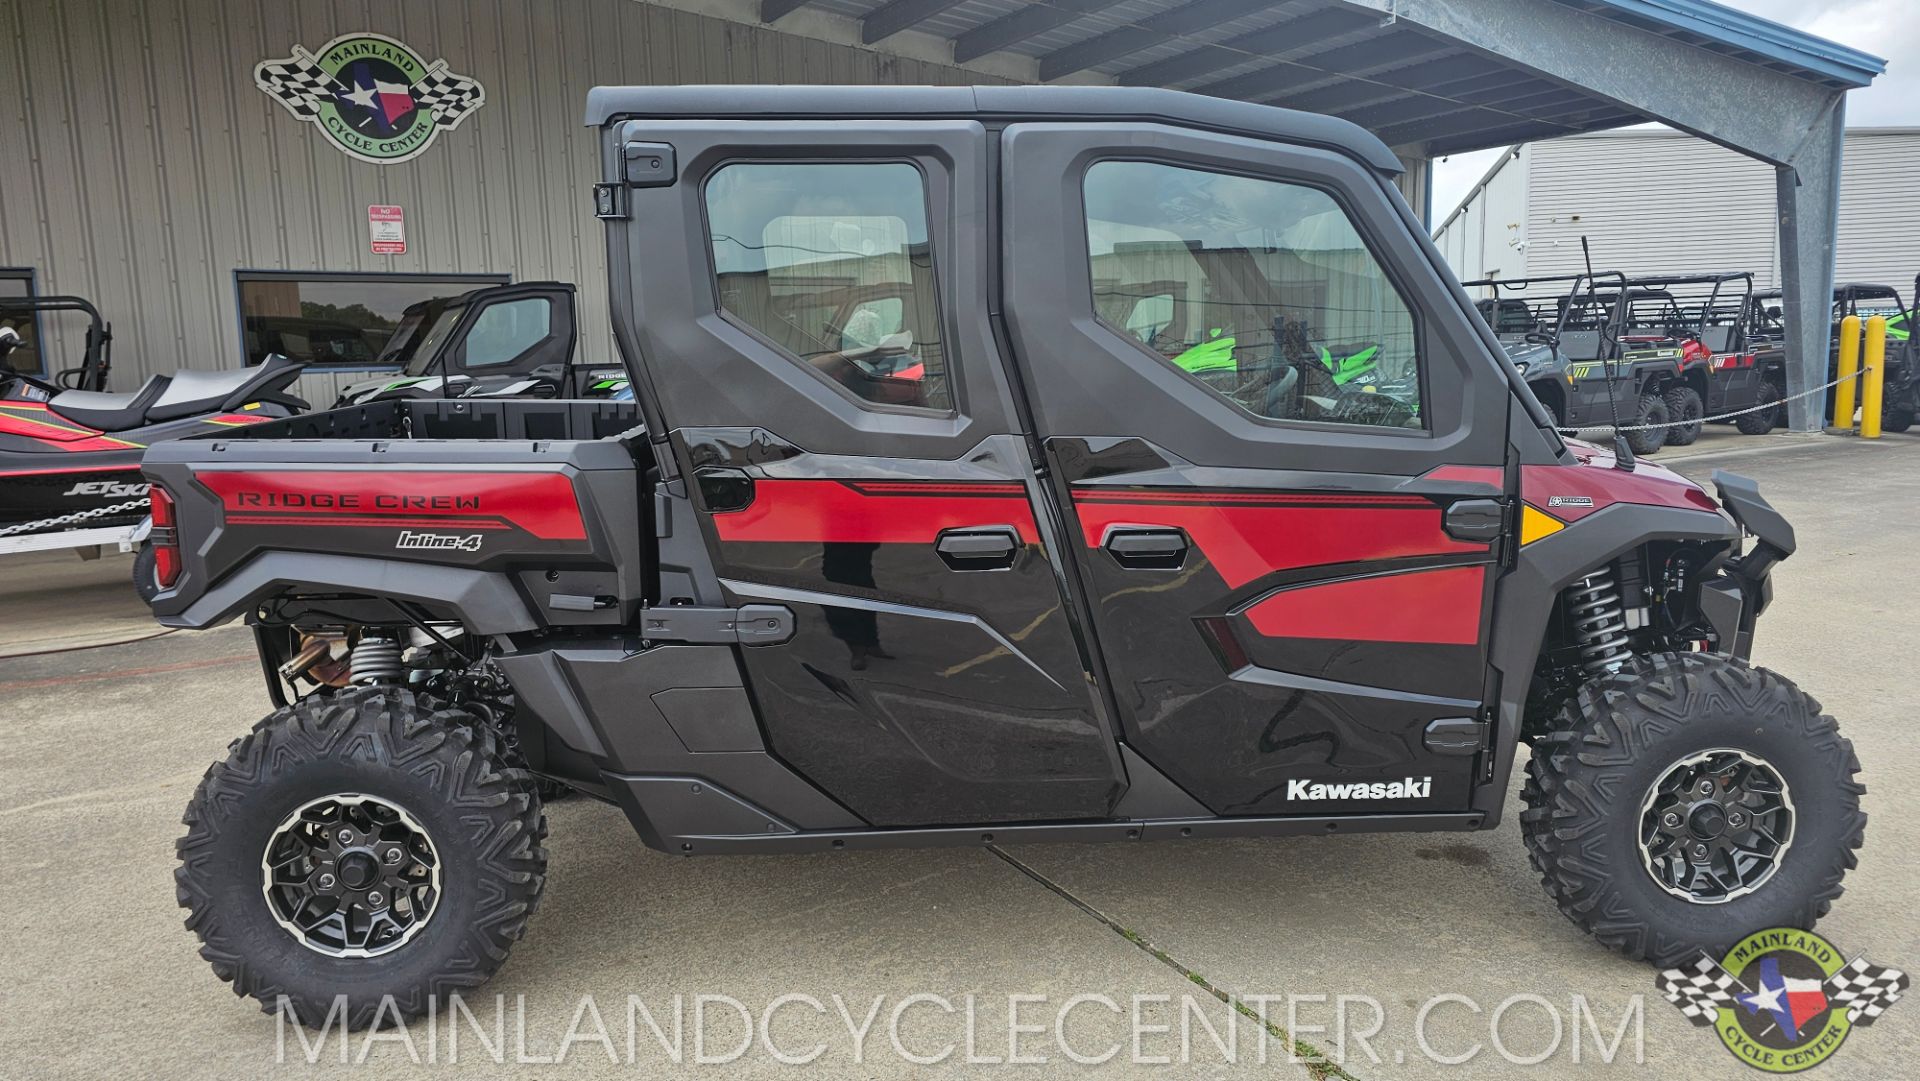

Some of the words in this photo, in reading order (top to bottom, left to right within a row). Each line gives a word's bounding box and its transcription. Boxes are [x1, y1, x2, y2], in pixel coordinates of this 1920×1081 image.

[330, 43, 415, 72] MAINLAND
[327, 116, 374, 151] CYCLE
[379, 121, 429, 153] CENTER
[238, 492, 360, 508] RIDGE
[375, 494, 480, 510] CREW
[395, 531, 483, 552] Inline-4
[1287, 776, 1432, 800] Kawasaki
